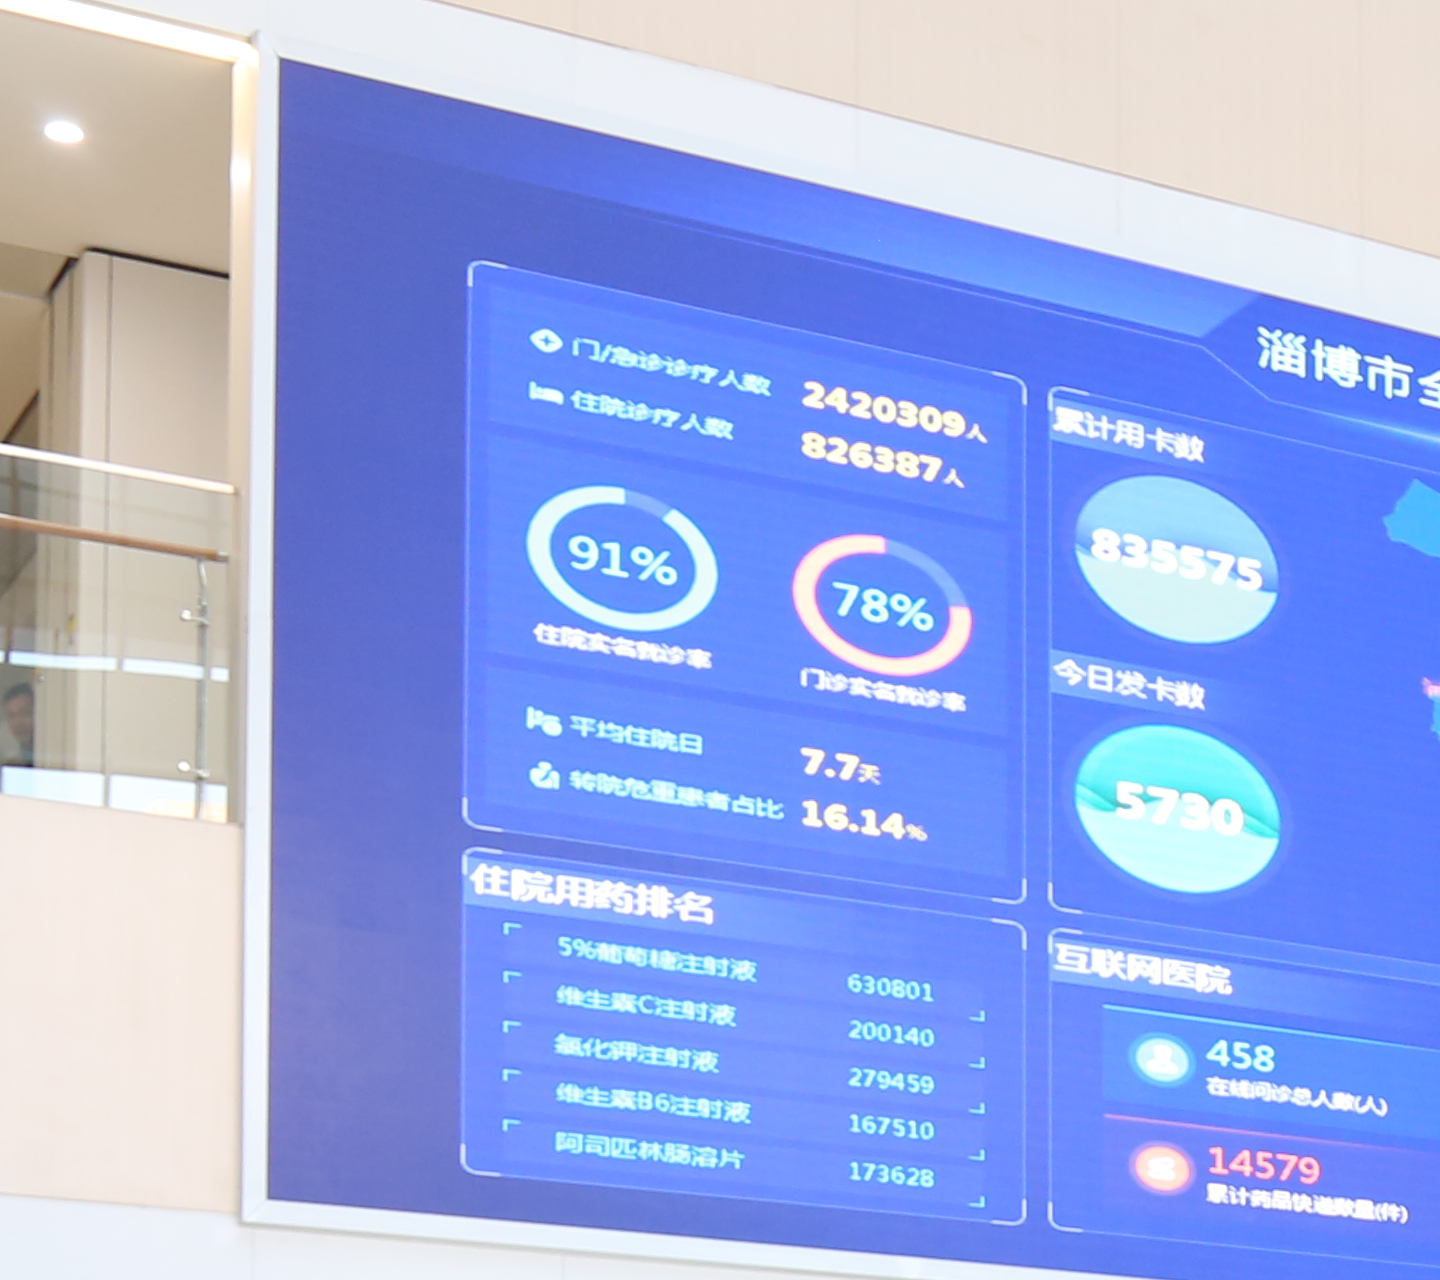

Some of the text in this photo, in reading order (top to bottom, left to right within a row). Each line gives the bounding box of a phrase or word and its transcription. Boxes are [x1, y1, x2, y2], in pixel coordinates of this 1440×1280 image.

[572, 338, 772, 396] 门/急诊诊疗人数
[571, 390, 734, 440] 住院诊疗人数
[1053, 407, 1205, 463] 累计用卡数
[569, 535, 678, 585] 91%
[1091, 529, 1263, 591] 835575
[831, 581, 934, 632] 78%
[534, 623, 712, 669] 住院实名就诊率
[801, 667, 966, 712] 门诊实名就诊率
[1053, 659, 1205, 711] 今日发卡数
[571, 715, 703, 755] 平均住院日
[801, 747, 881, 785] 7.7天
[570, 769, 784, 820] 转院危重患者占比
[1115, 781, 1244, 836] 5730
[801, 800, 927, 842] 16.14%
[470, 863, 714, 924] 住院用药排名
[848, 974, 934, 1002] 630801
[1054, 943, 1232, 995] 互联网医院
[557, 985, 737, 1027] 维生素C注射液
[849, 1020, 934, 1047] 200140
[1206, 1040, 1275, 1072] 458
[848, 1068, 934, 1095] 279459
[556, 1084, 751, 1124] 维生素B6注射液
[850, 1114, 934, 1140] 167510
[556, 1132, 745, 1170] 阿司匹林肠溶片
[1209, 1147, 1320, 1185] 14579
[850, 1162, 934, 1188] 173628
